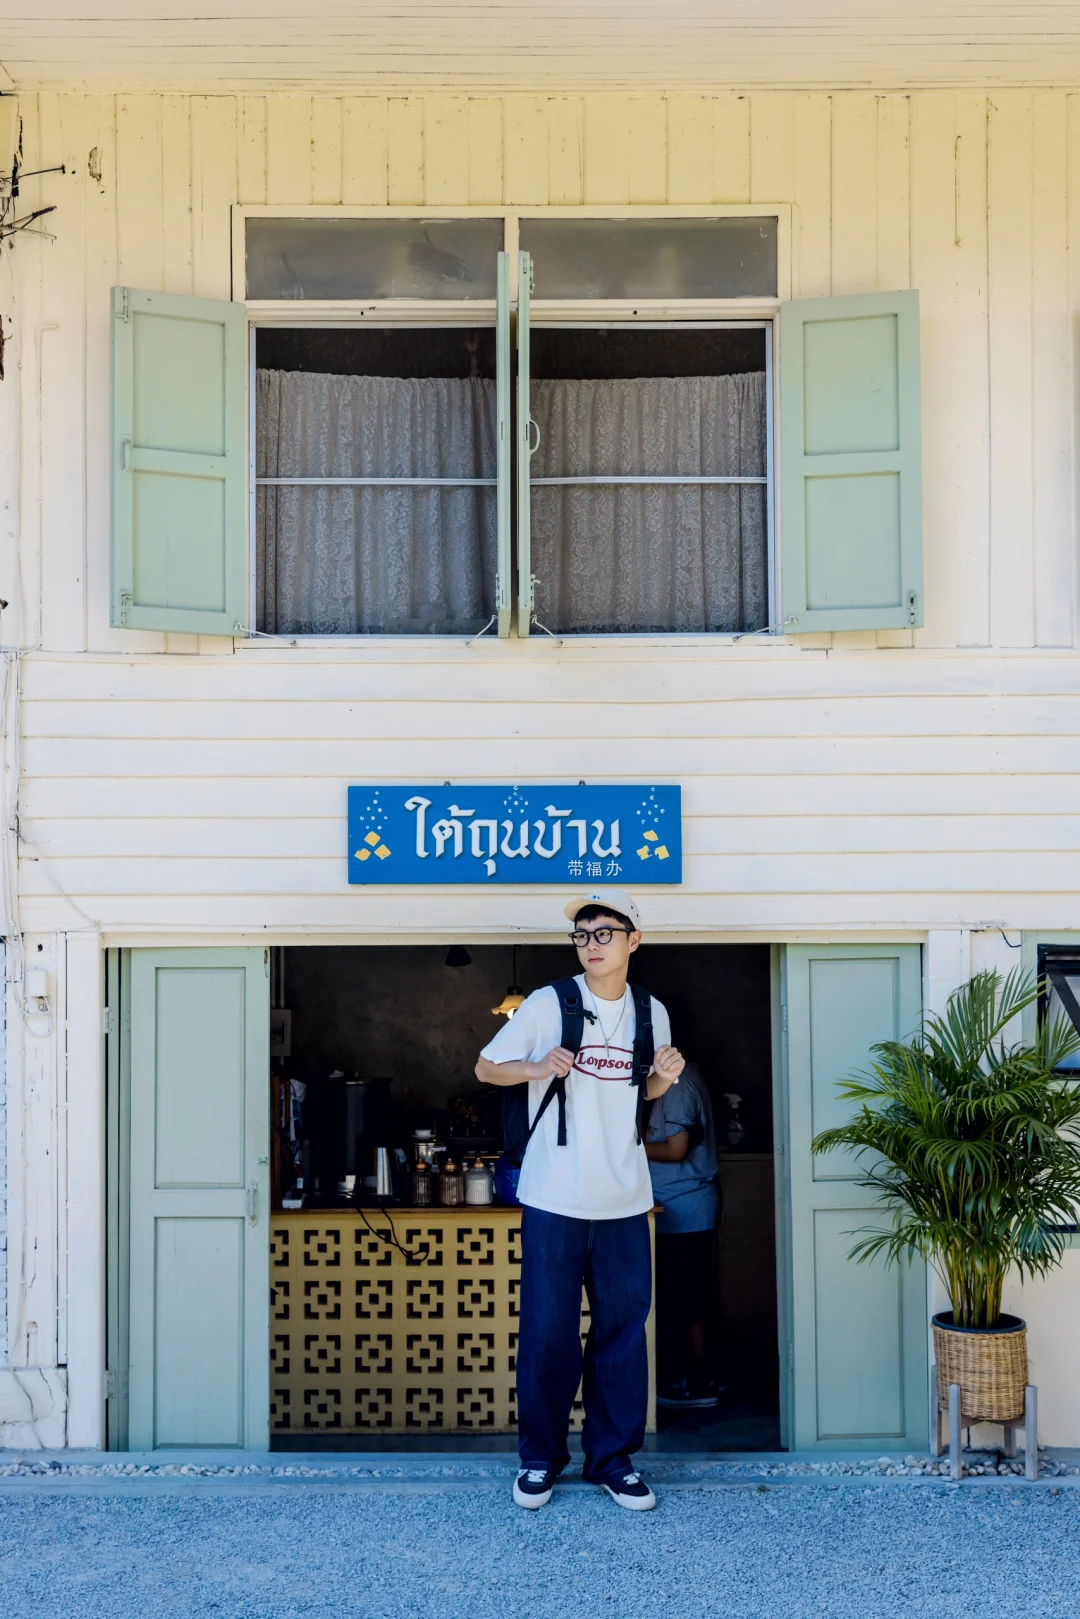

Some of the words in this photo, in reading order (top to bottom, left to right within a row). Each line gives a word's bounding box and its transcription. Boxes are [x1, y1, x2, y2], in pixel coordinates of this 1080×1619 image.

[404, 796, 622, 877] ใต้ถุนบ้าน
[568, 860, 623, 877] 带福办
